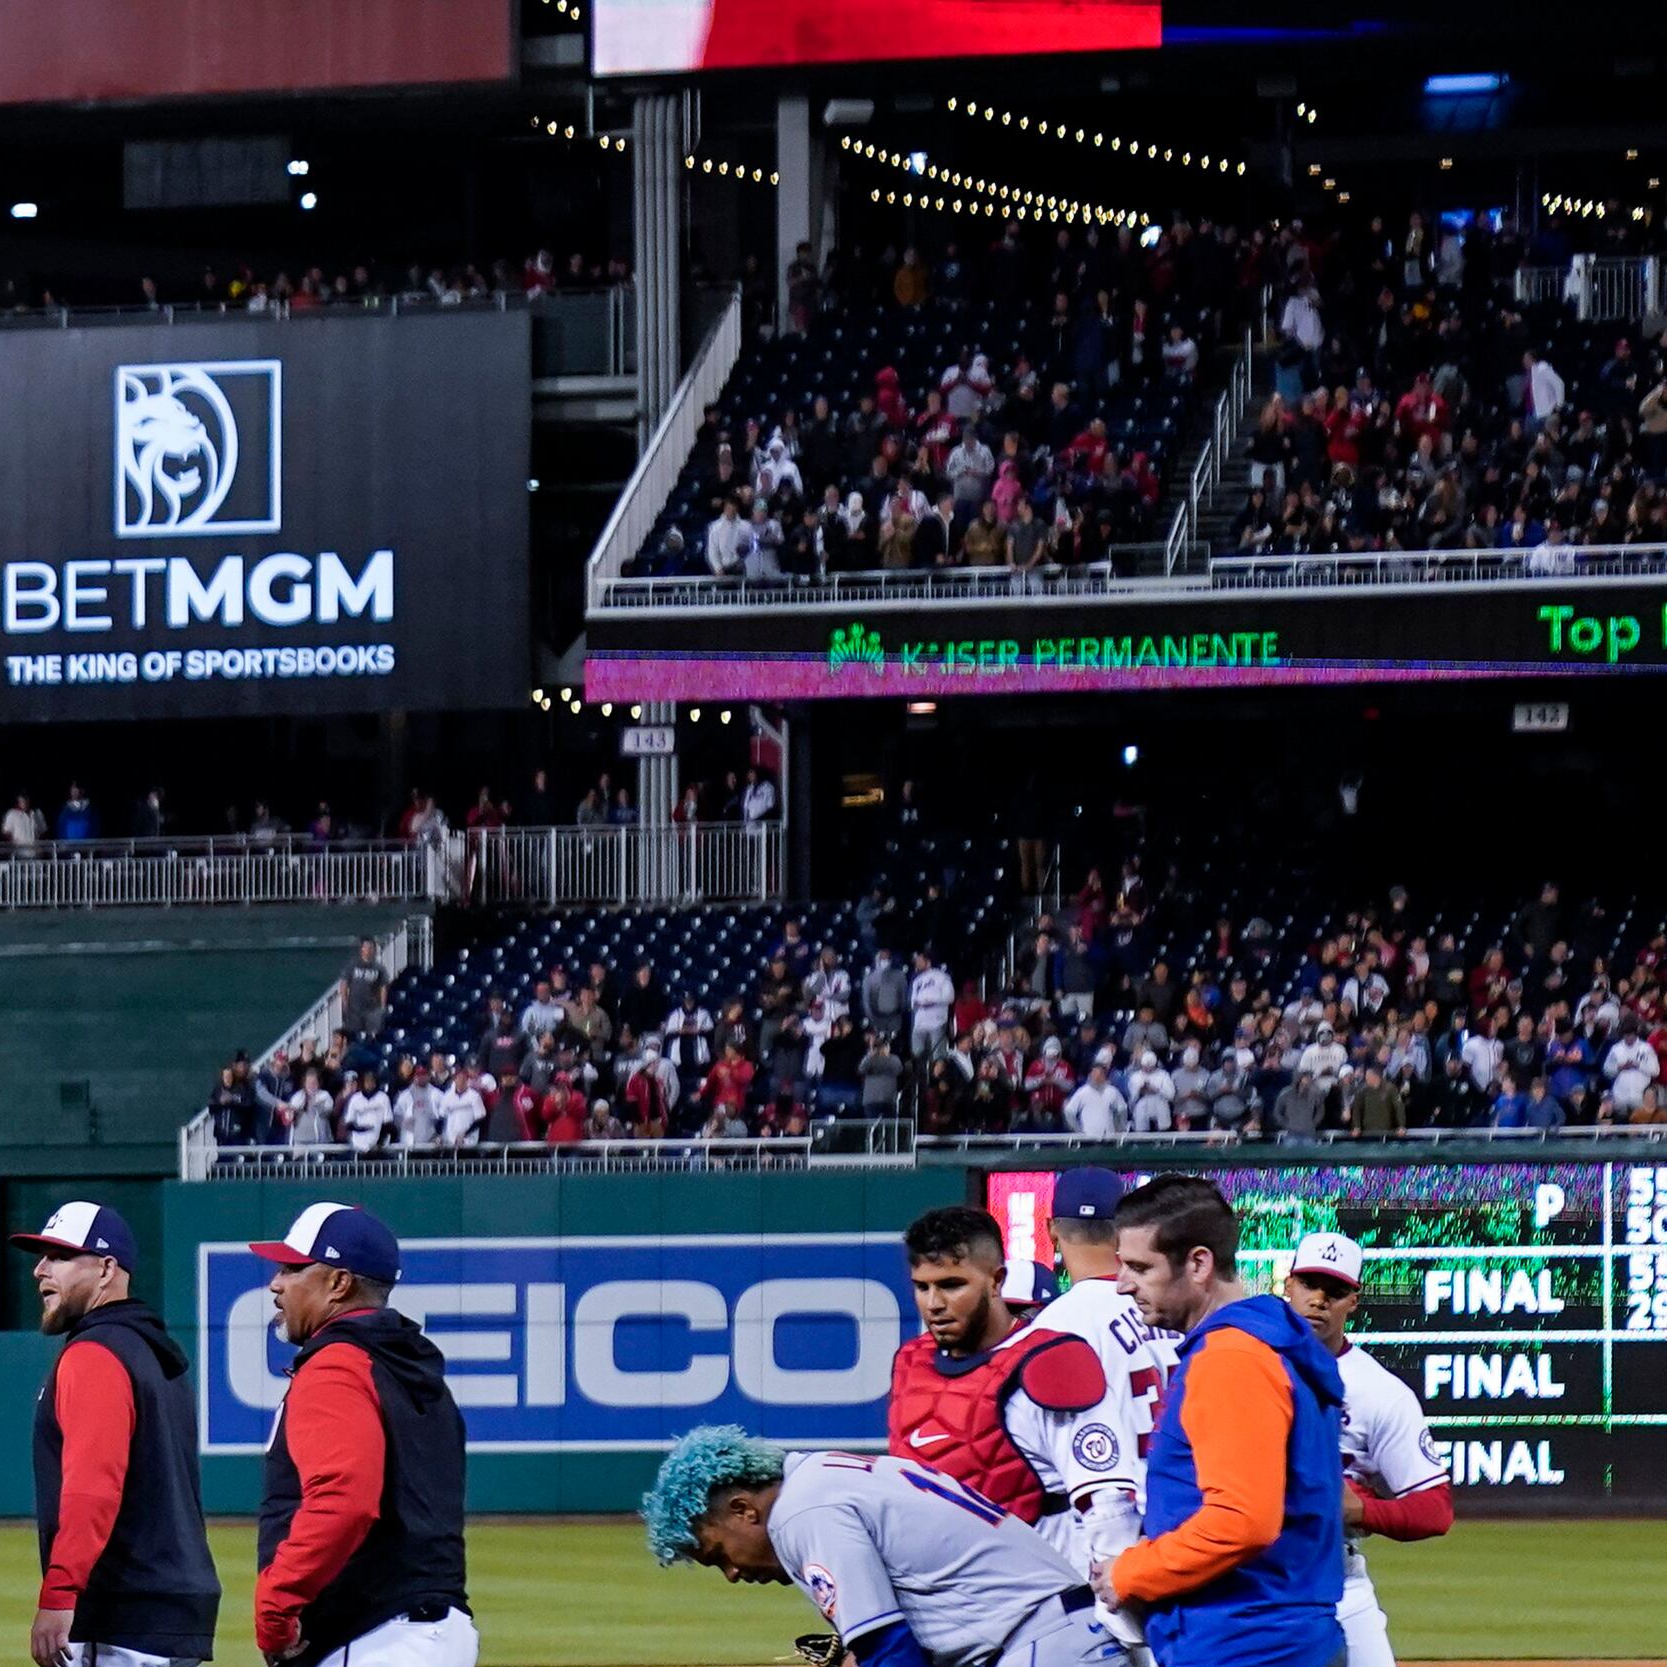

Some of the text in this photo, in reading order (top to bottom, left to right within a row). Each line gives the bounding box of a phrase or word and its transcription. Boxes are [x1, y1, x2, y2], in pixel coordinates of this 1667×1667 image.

[2, 549, 395, 634] BETMGM
[1033, 630, 1281, 674] PERMANENTE
[1537, 604, 1642, 664] Top
[6, 644, 396, 685] THE KING OF SPORTSBOOKS
[1534, 1182, 1566, 1229] P
[1423, 1267, 1565, 1316] FINAL
[1423, 1353, 1565, 1399] FINAL
